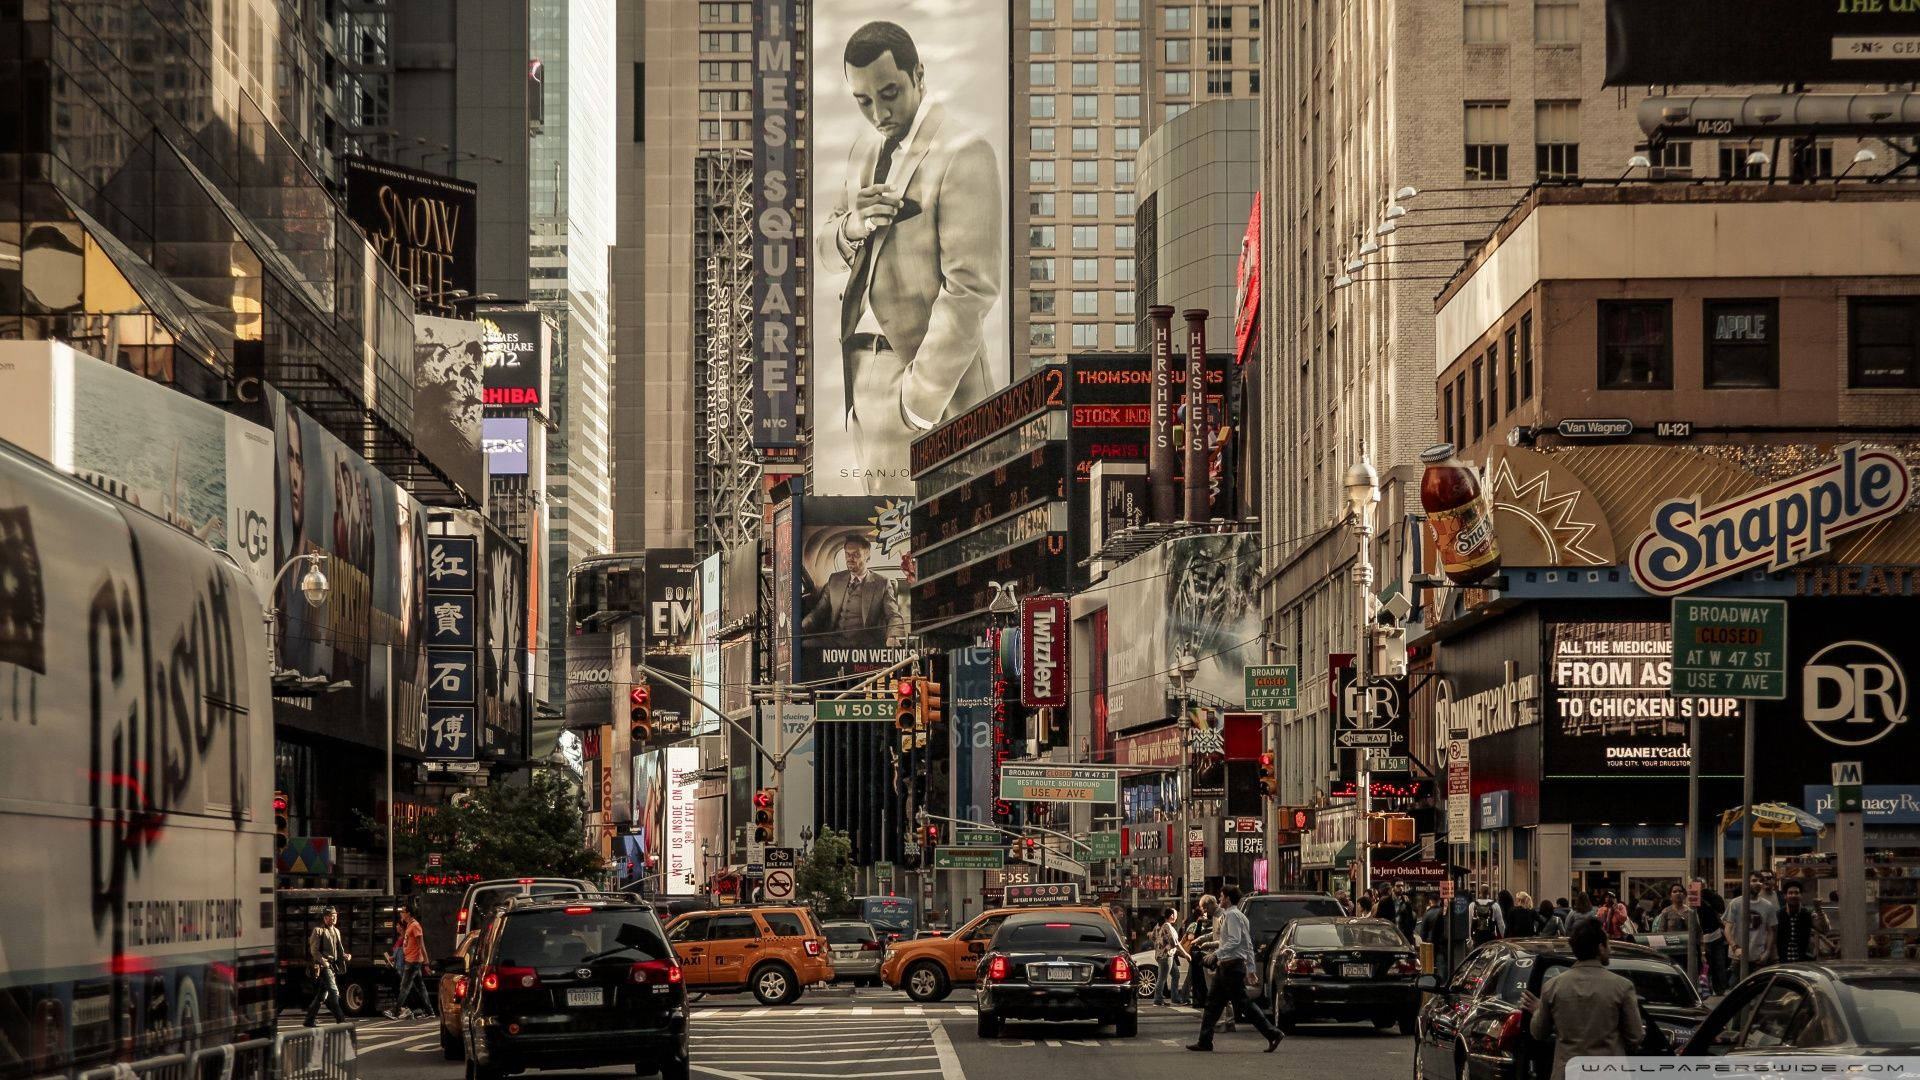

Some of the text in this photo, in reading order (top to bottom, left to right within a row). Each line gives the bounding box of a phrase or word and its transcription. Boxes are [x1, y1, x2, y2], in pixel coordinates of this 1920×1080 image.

[1892, 42, 1920, 53] GE
[1698, 120, 1732, 134] M-120
[367, 163, 378, 173] THE
[379, 167, 407, 180] PRODUCER
[416, 175, 431, 184] ALICE
[440, 181, 476, 195] WONDERLAND
[379, 185, 459, 253] SNOW
[759, 170, 793, 391] SQUARE
[1715, 315, 1765, 340] APPLE
[707, 257, 718, 461] AMERICAN EAGLE
[718, 286, 730, 429] OUTFITTERS
[1077, 370, 1152, 384] THOMSON
[1157, 328, 1167, 448] HERSHEYS
[1191, 332, 1203, 451] HERSHEYS
[762, 418, 787, 428] NYC
[1075, 409, 1121, 423] STOCK
[1566, 421, 1627, 435] Van Wagner
[1658, 424, 1690, 436] M-121
[1648, 447, 1892, 582] Snapple
[236, 507, 268, 563] UGG
[652, 602, 692, 637] EM
[1689, 606, 1769, 624] BROADWAY
[1701, 628, 1758, 644] CLOSED
[1558, 641, 1583, 654] ALL
[1585, 641, 1609, 654] THE
[822, 650, 849, 663] NOW
[852, 650, 868, 663] ON
[1686, 651, 1771, 667] AT W 47 ST
[1251, 668, 1290, 677] BROADWAY
[1558, 662, 1631, 686] FROM
[1257, 678, 1285, 686] CLOSED
[1687, 673, 1769, 690] USE 7 AVE
[1251, 687, 1291, 696] AT W 47 ST
[1803, 664, 1908, 723] DR
[957, 697, 983, 709] Morgan
[1252, 698, 1290, 707] USE 7 AVE
[1557, 698, 1740, 717] TO CHICKEN SOUP.
[834, 703, 894, 717] W 50 St
[1343, 735, 1360, 743] ONE
[1366, 735, 1384, 743] WAY
[1369, 749, 1389, 758] PEN
[1380, 759, 1387, 769] W
[1388, 759, 1398, 769] 50
[1008, 769, 1043, 777] BROADWAY
[672, 789, 683, 801] ON
[1031, 788, 1086, 798] USE 7 AVE
[672, 805, 683, 833] INSIDE
[672, 838, 683, 849] US
[985, 834, 993, 842] St
[1573, 836, 1682, 847] DOCTOR ON PREMISES
[1370, 866, 1445, 877] The Jerry Orbach Theater
